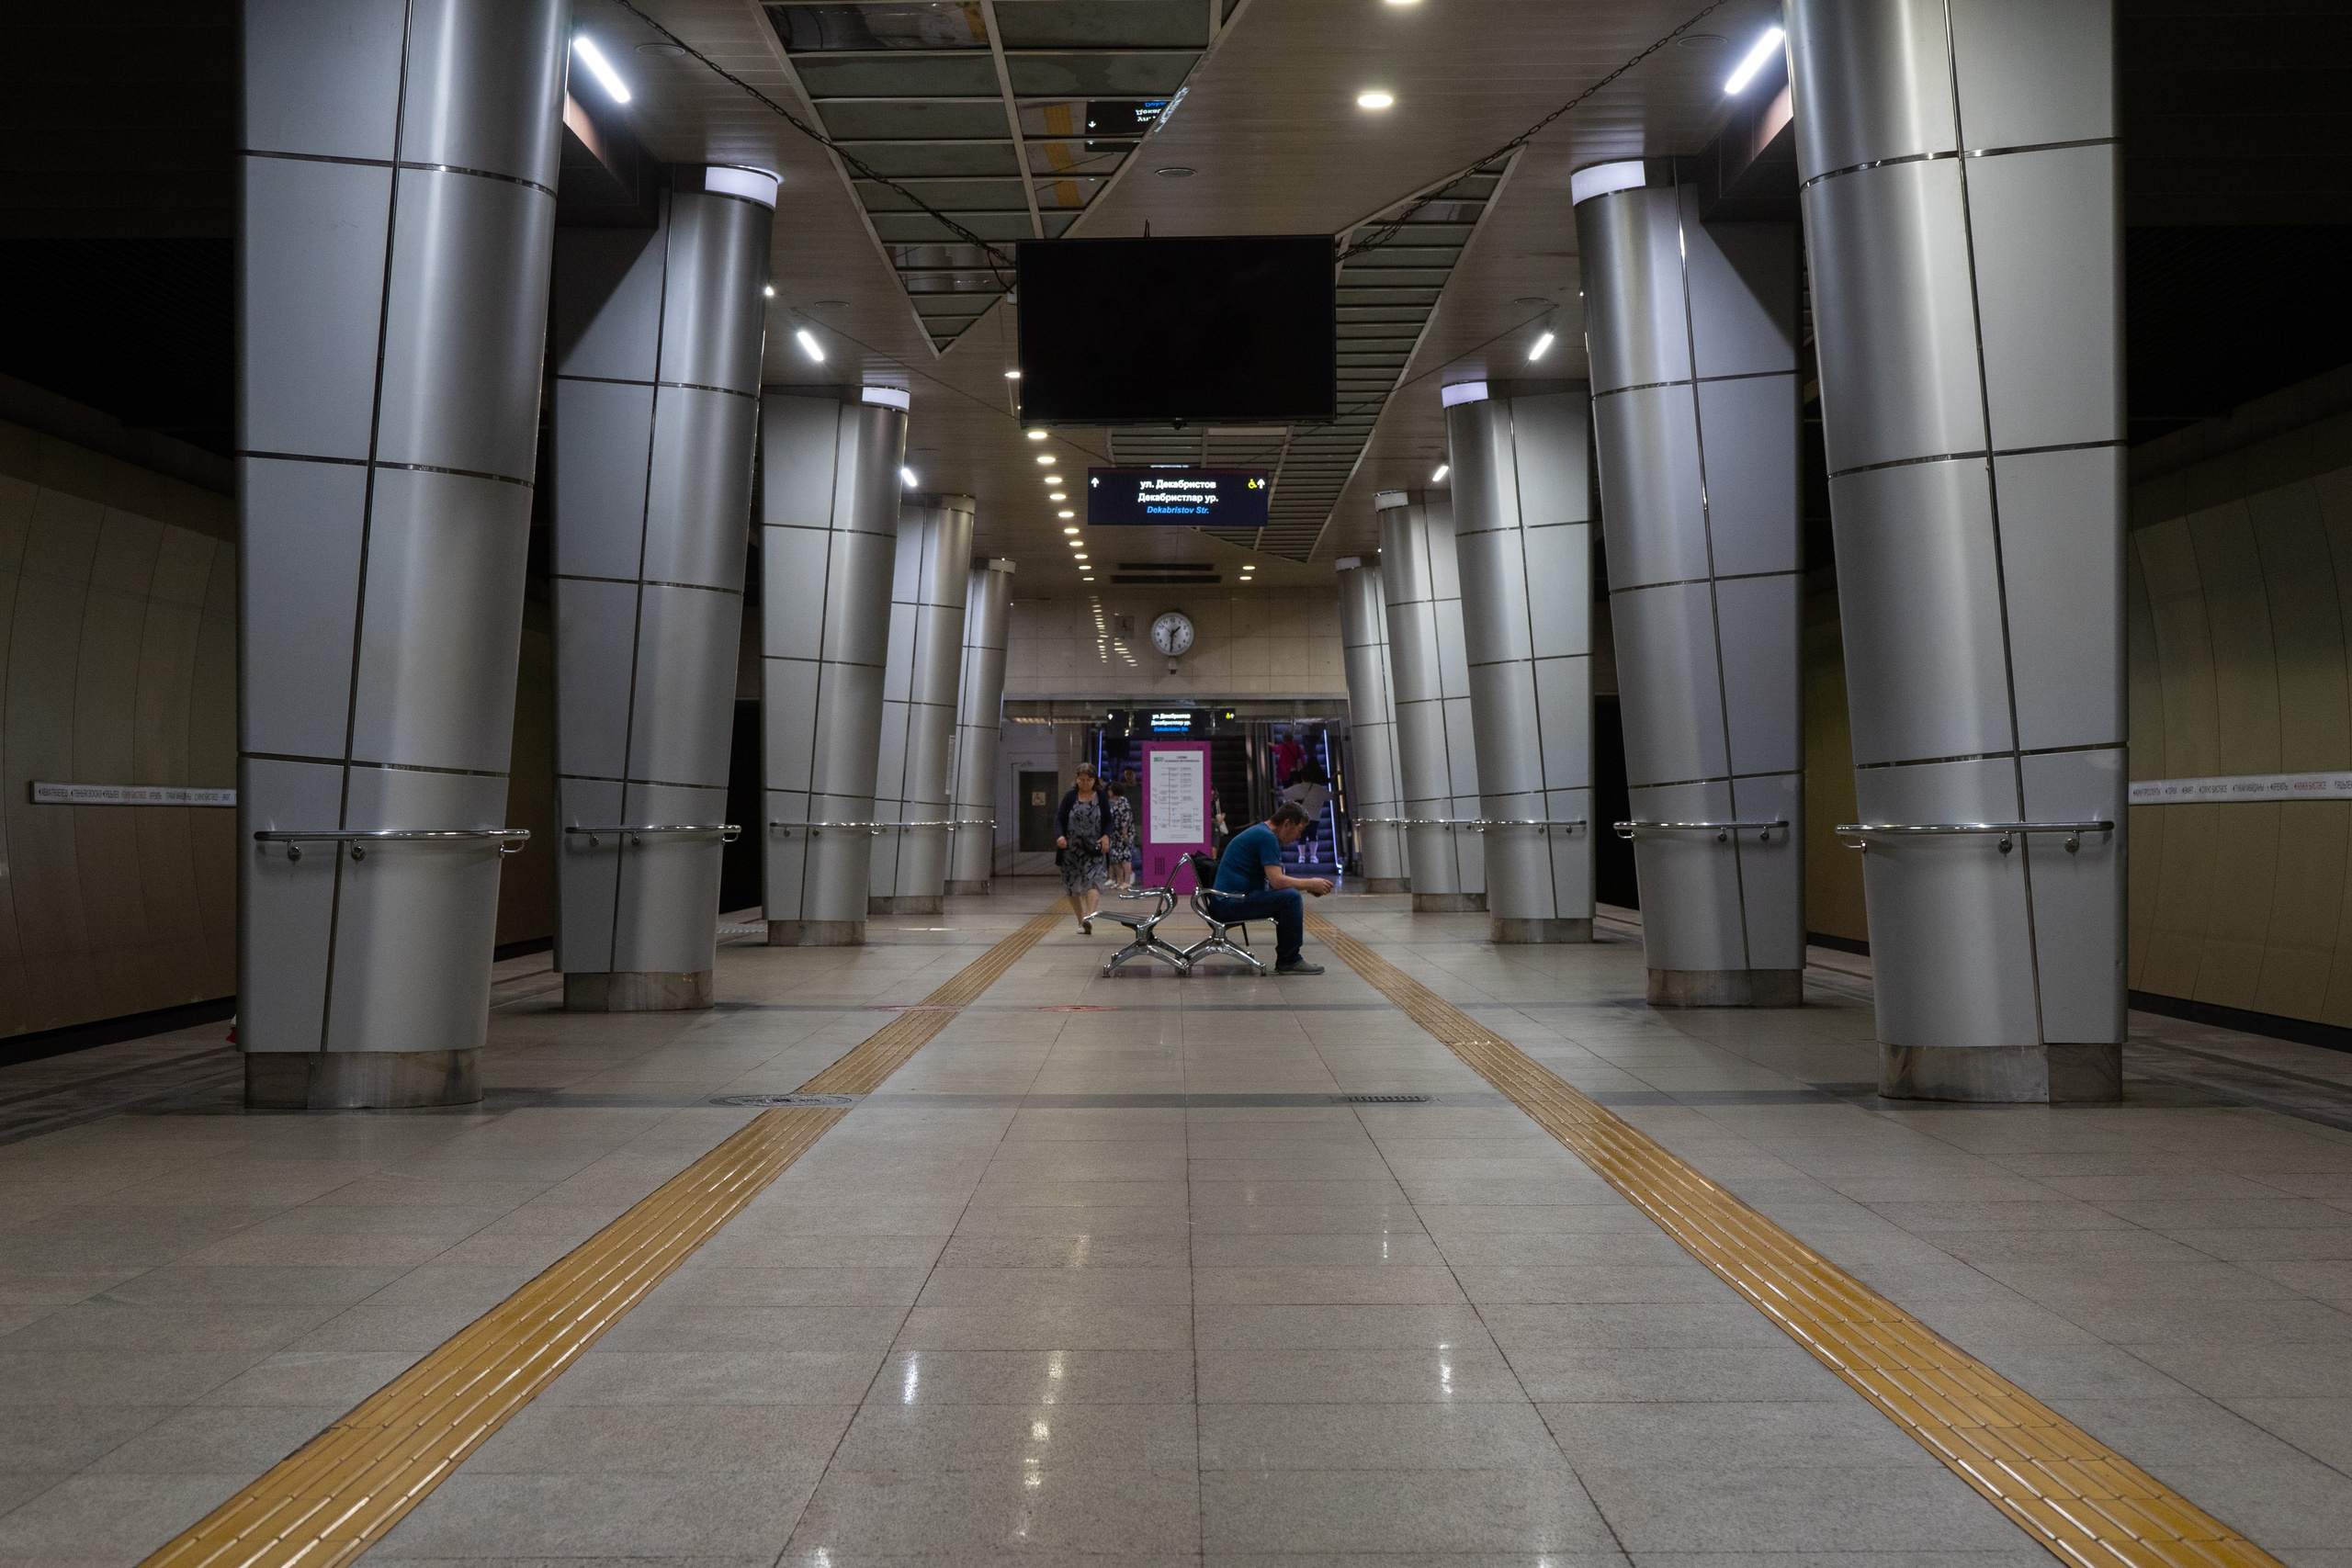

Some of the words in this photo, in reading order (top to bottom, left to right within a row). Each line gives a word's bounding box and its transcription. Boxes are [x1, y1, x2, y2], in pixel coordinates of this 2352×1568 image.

[1140, 480, 1154, 491] ул.
[1156, 479, 1216, 491] Декабристов
[1137, 493, 1203, 503] Декабристлар
[1204, 494, 1218, 503] ур.
[1147, 506, 1194, 514] Dekabristov
[1195, 506, 1209, 514] Str.
